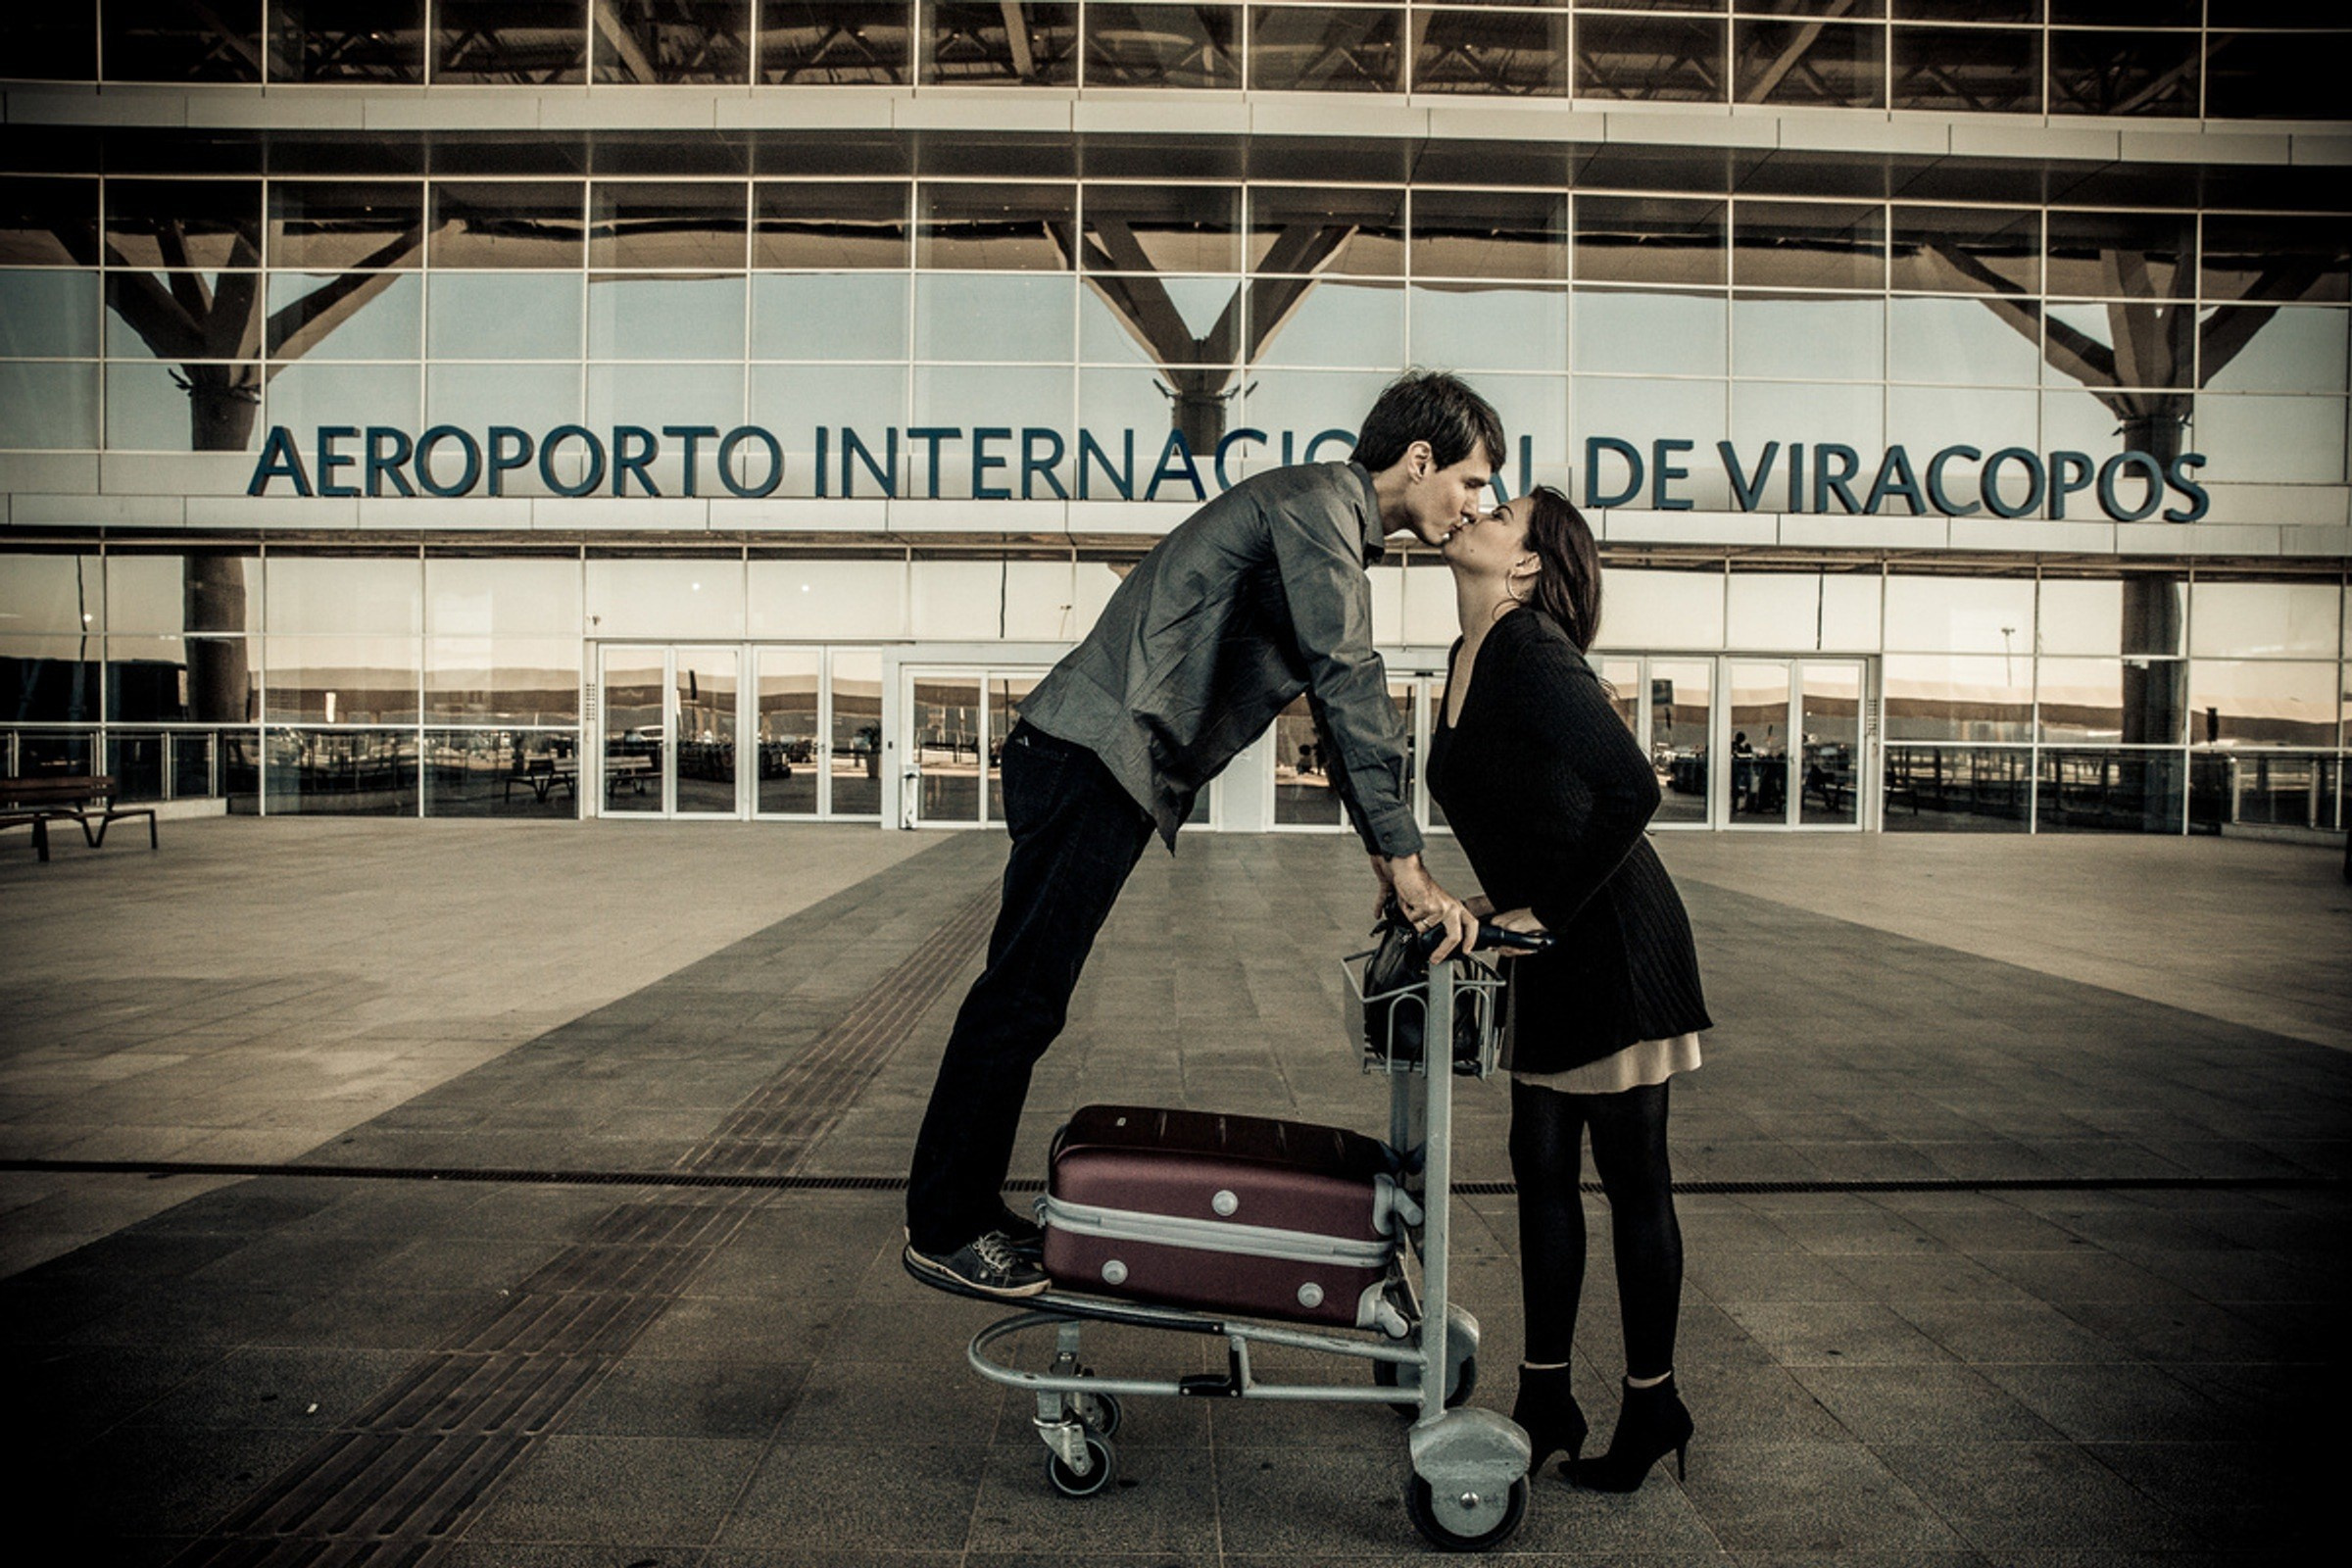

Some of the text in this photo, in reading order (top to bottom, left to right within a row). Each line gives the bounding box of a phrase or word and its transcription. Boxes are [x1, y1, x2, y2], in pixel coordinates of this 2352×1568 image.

[247, 424, 2210, 523] AEROPORTO INTERNACL DE VIRACOPOS
